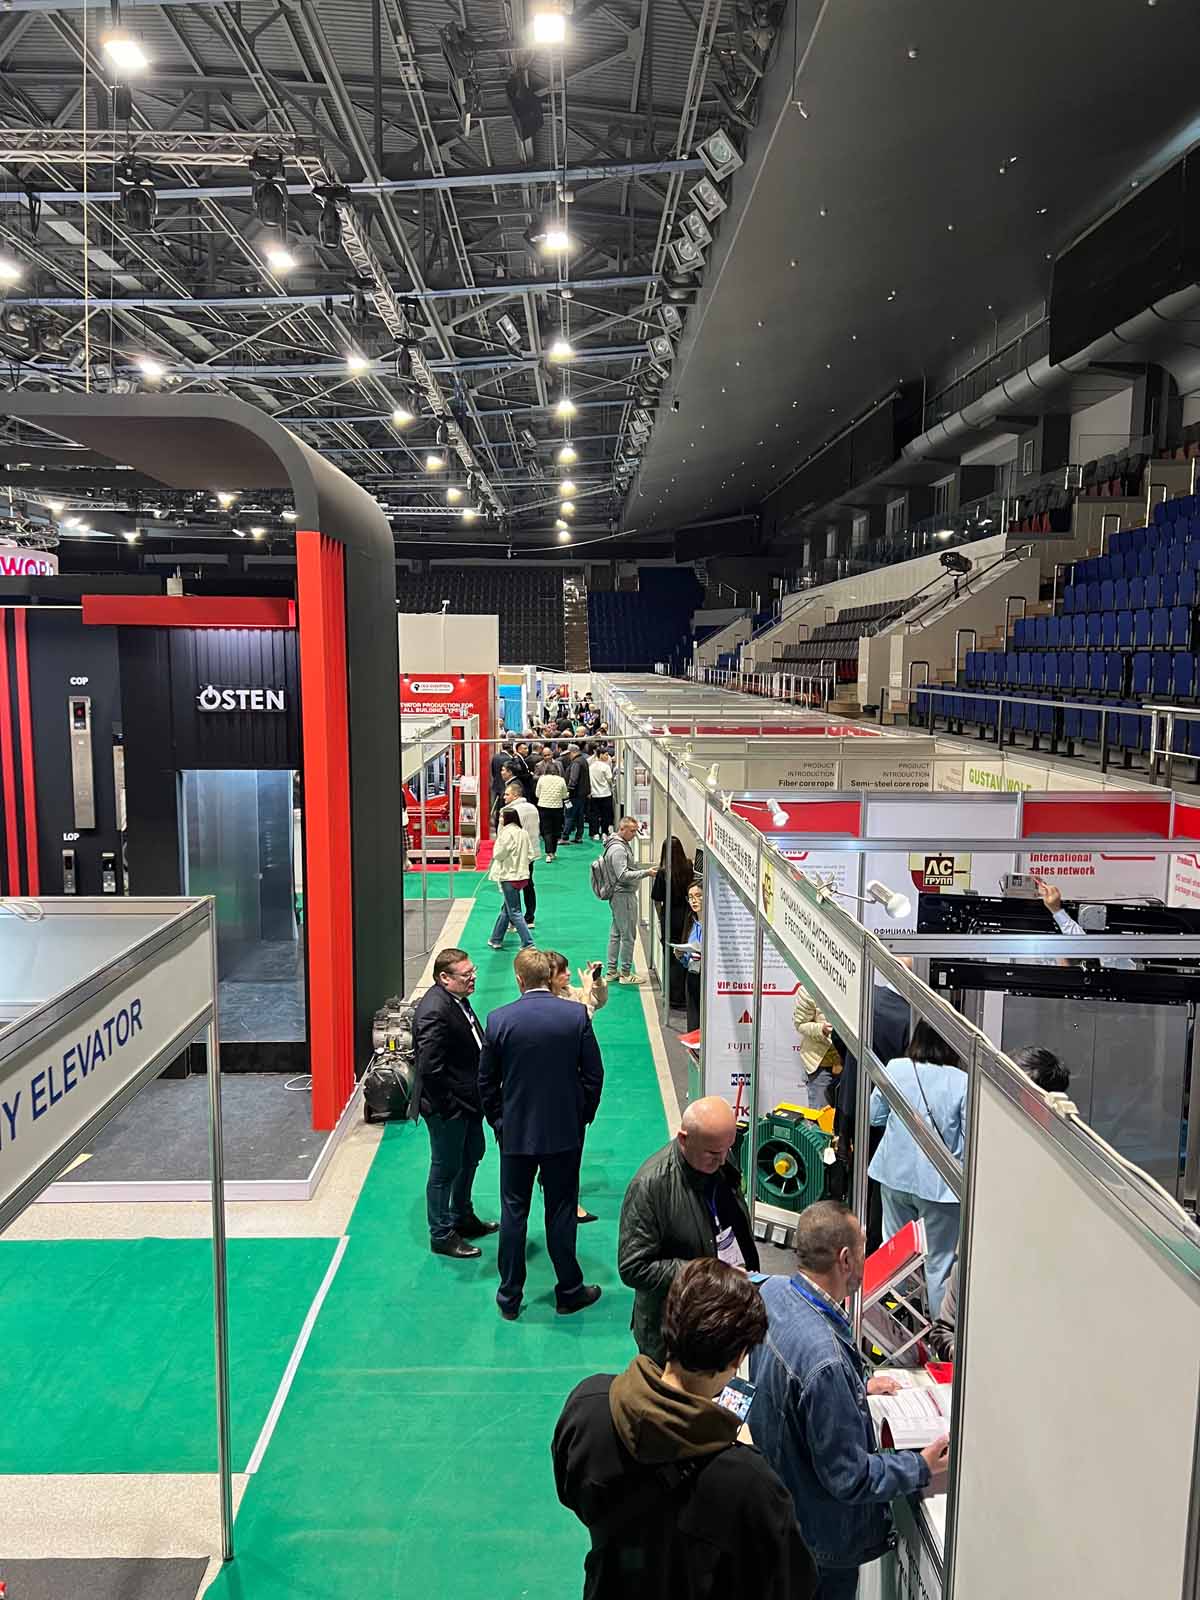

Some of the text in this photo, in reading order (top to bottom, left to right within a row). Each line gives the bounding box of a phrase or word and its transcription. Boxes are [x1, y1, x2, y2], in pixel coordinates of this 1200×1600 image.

[70, 676, 89, 686] COP
[850, 779, 893, 787] Semi-steel
[911, 781, 929, 789] rope
[968, 767, 1003, 791] GUSTAV
[817, 781, 835, 789] rope
[63, 832, 80, 841] LOP
[1030, 852, 1092, 862] International
[1030, 865, 1096, 875] sales network
[925, 877, 953, 885] ГРУПП
[811, 919, 857, 977] ДИСТРИБЬЮТОР
[816, 949, 847, 995] КАЗАХСТАН
[717, 981, 777, 990] VIP Custers
[30, 998, 143, 1121] ELEVATOR
